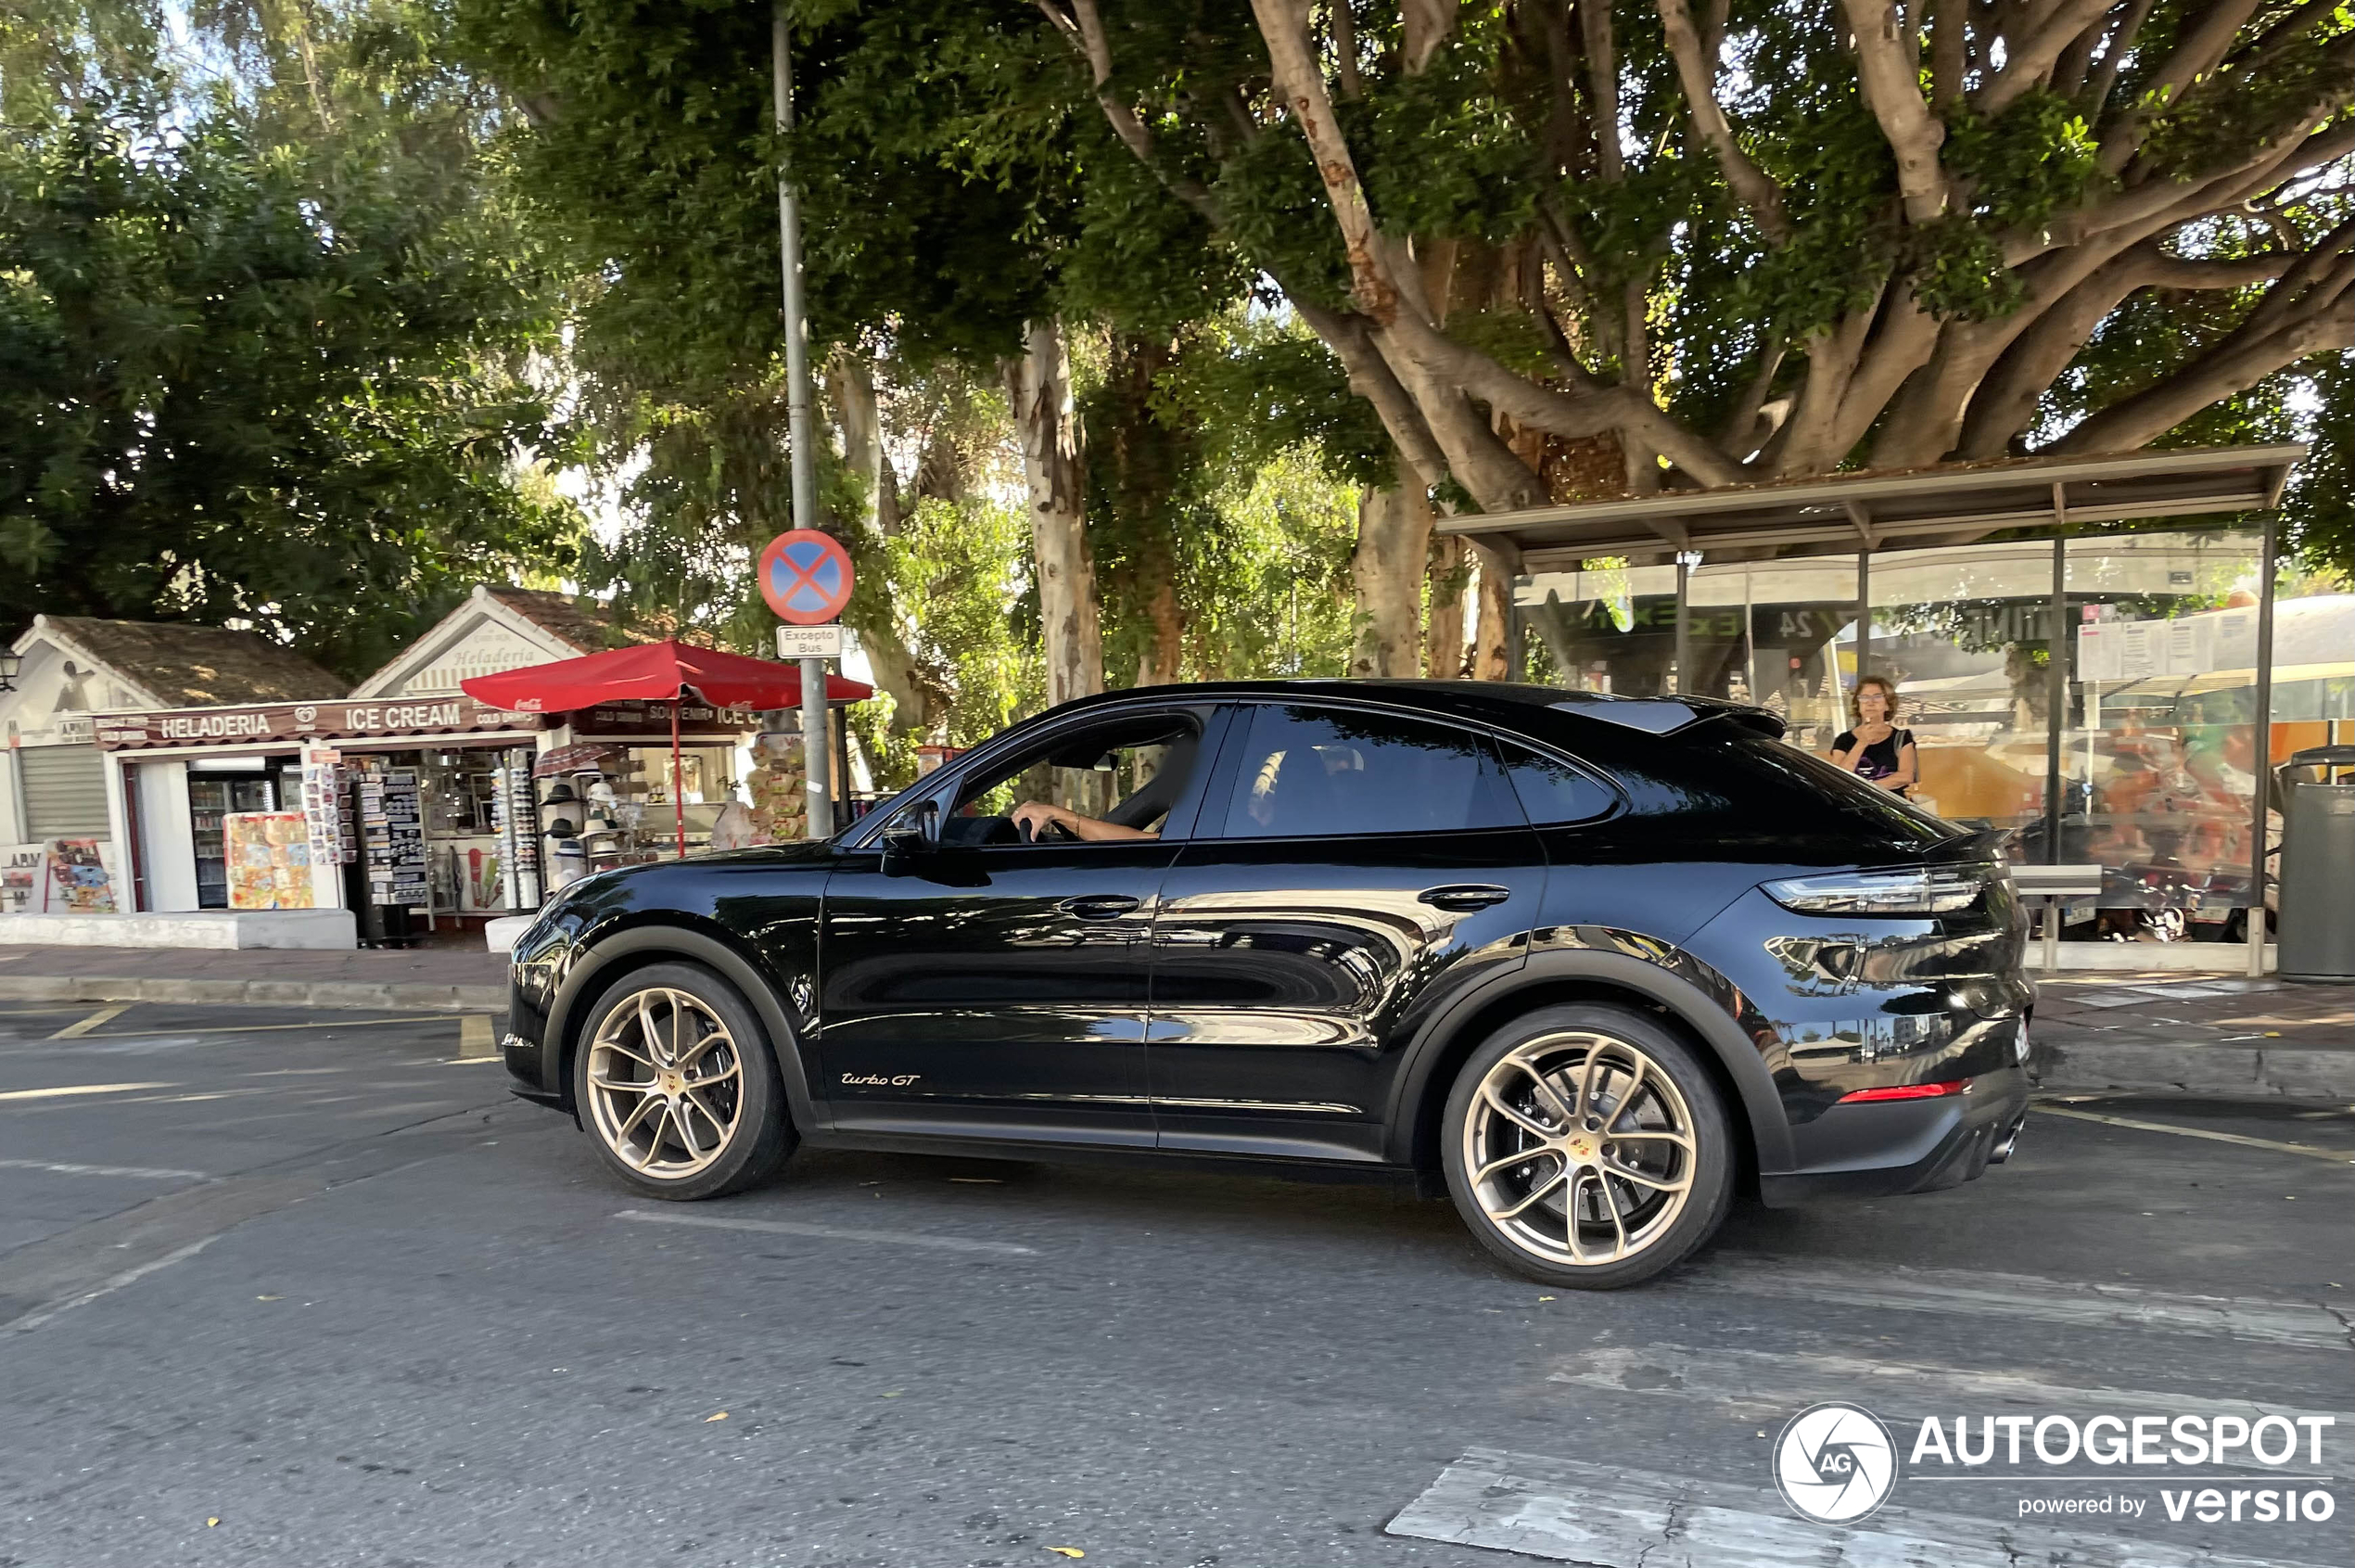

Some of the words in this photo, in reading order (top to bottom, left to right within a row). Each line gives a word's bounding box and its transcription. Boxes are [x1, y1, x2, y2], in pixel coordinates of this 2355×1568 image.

[784, 631, 834, 642] Excepto
[798, 644, 822, 653] Bus
[346, 708, 381, 730] ICE
[385, 703, 461, 729] CREAM
[477, 713, 500, 724] COLD
[717, 707, 744, 725] ICE
[161, 713, 272, 739] HELADERIA
[891, 1075, 921, 1086] GT
